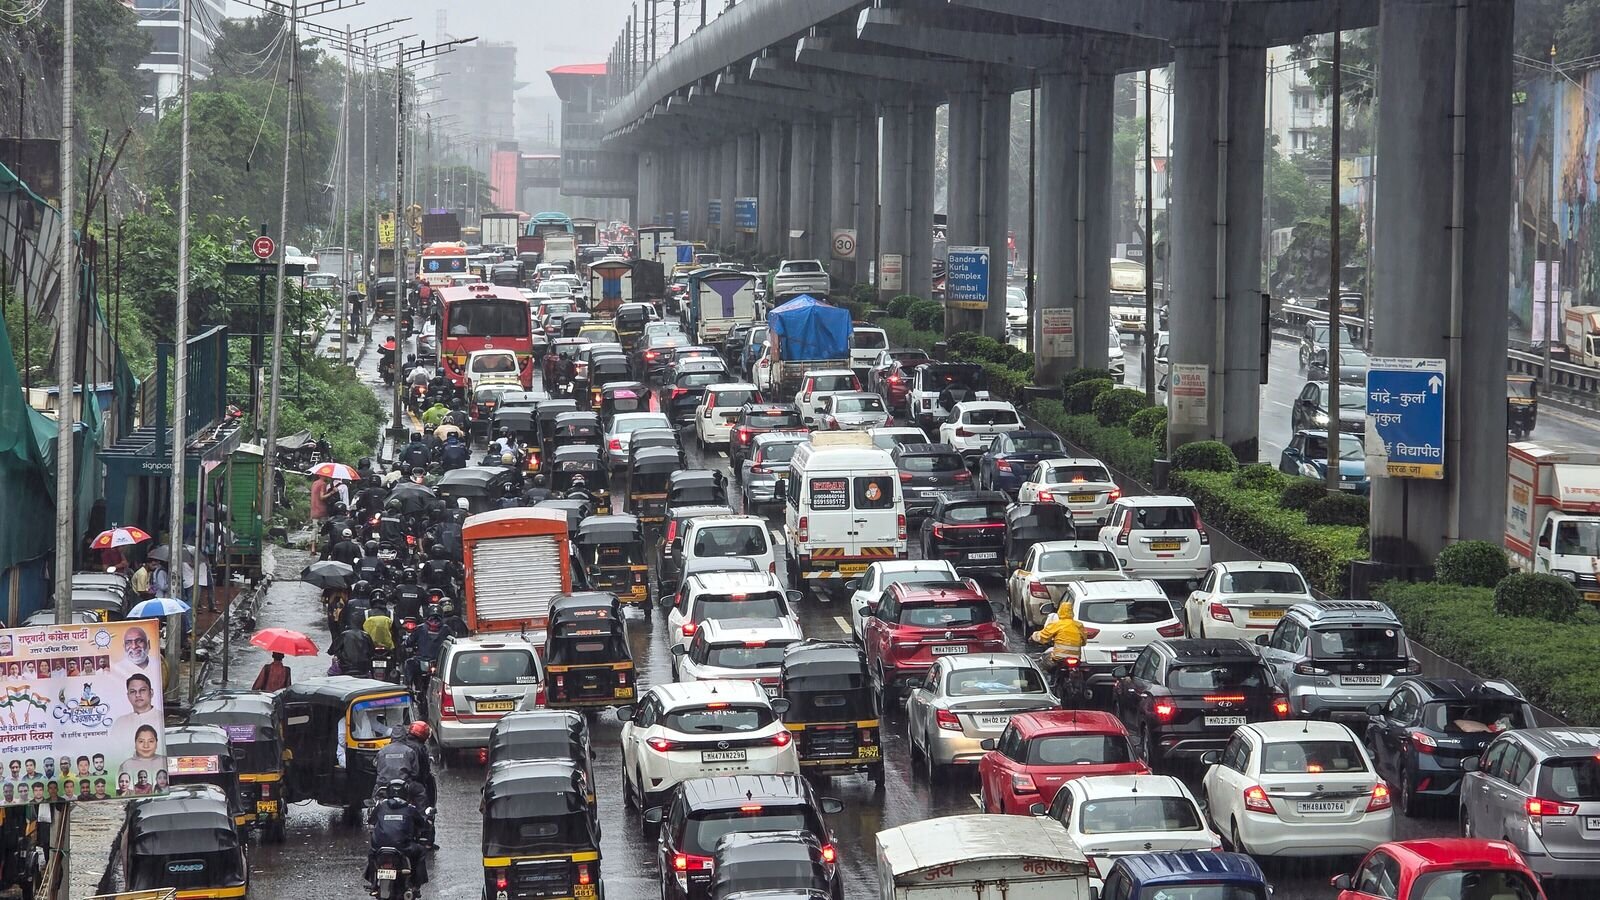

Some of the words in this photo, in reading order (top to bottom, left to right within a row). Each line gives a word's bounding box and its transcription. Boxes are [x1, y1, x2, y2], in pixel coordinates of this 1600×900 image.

[836, 239, 852, 250] 30
[949, 272, 981, 280] Complex
[949, 292, 986, 301] University
[1396, 442, 1441, 457] विद्यापीठ
[142, 461, 173, 470] signpost
[1409, 466, 1421, 474] जा
[48, 630, 70, 642] कांग्रेस
[71, 628, 88, 640] पार्टी
[29, 730, 54, 742] दिवस
[2, 746, 20, 754] हार्दिक
[1302, 803, 1344, 811] MH48AK0764
[924, 864, 955, 881] जय
[1022, 860, 1071, 876] महाराष्ट्र
